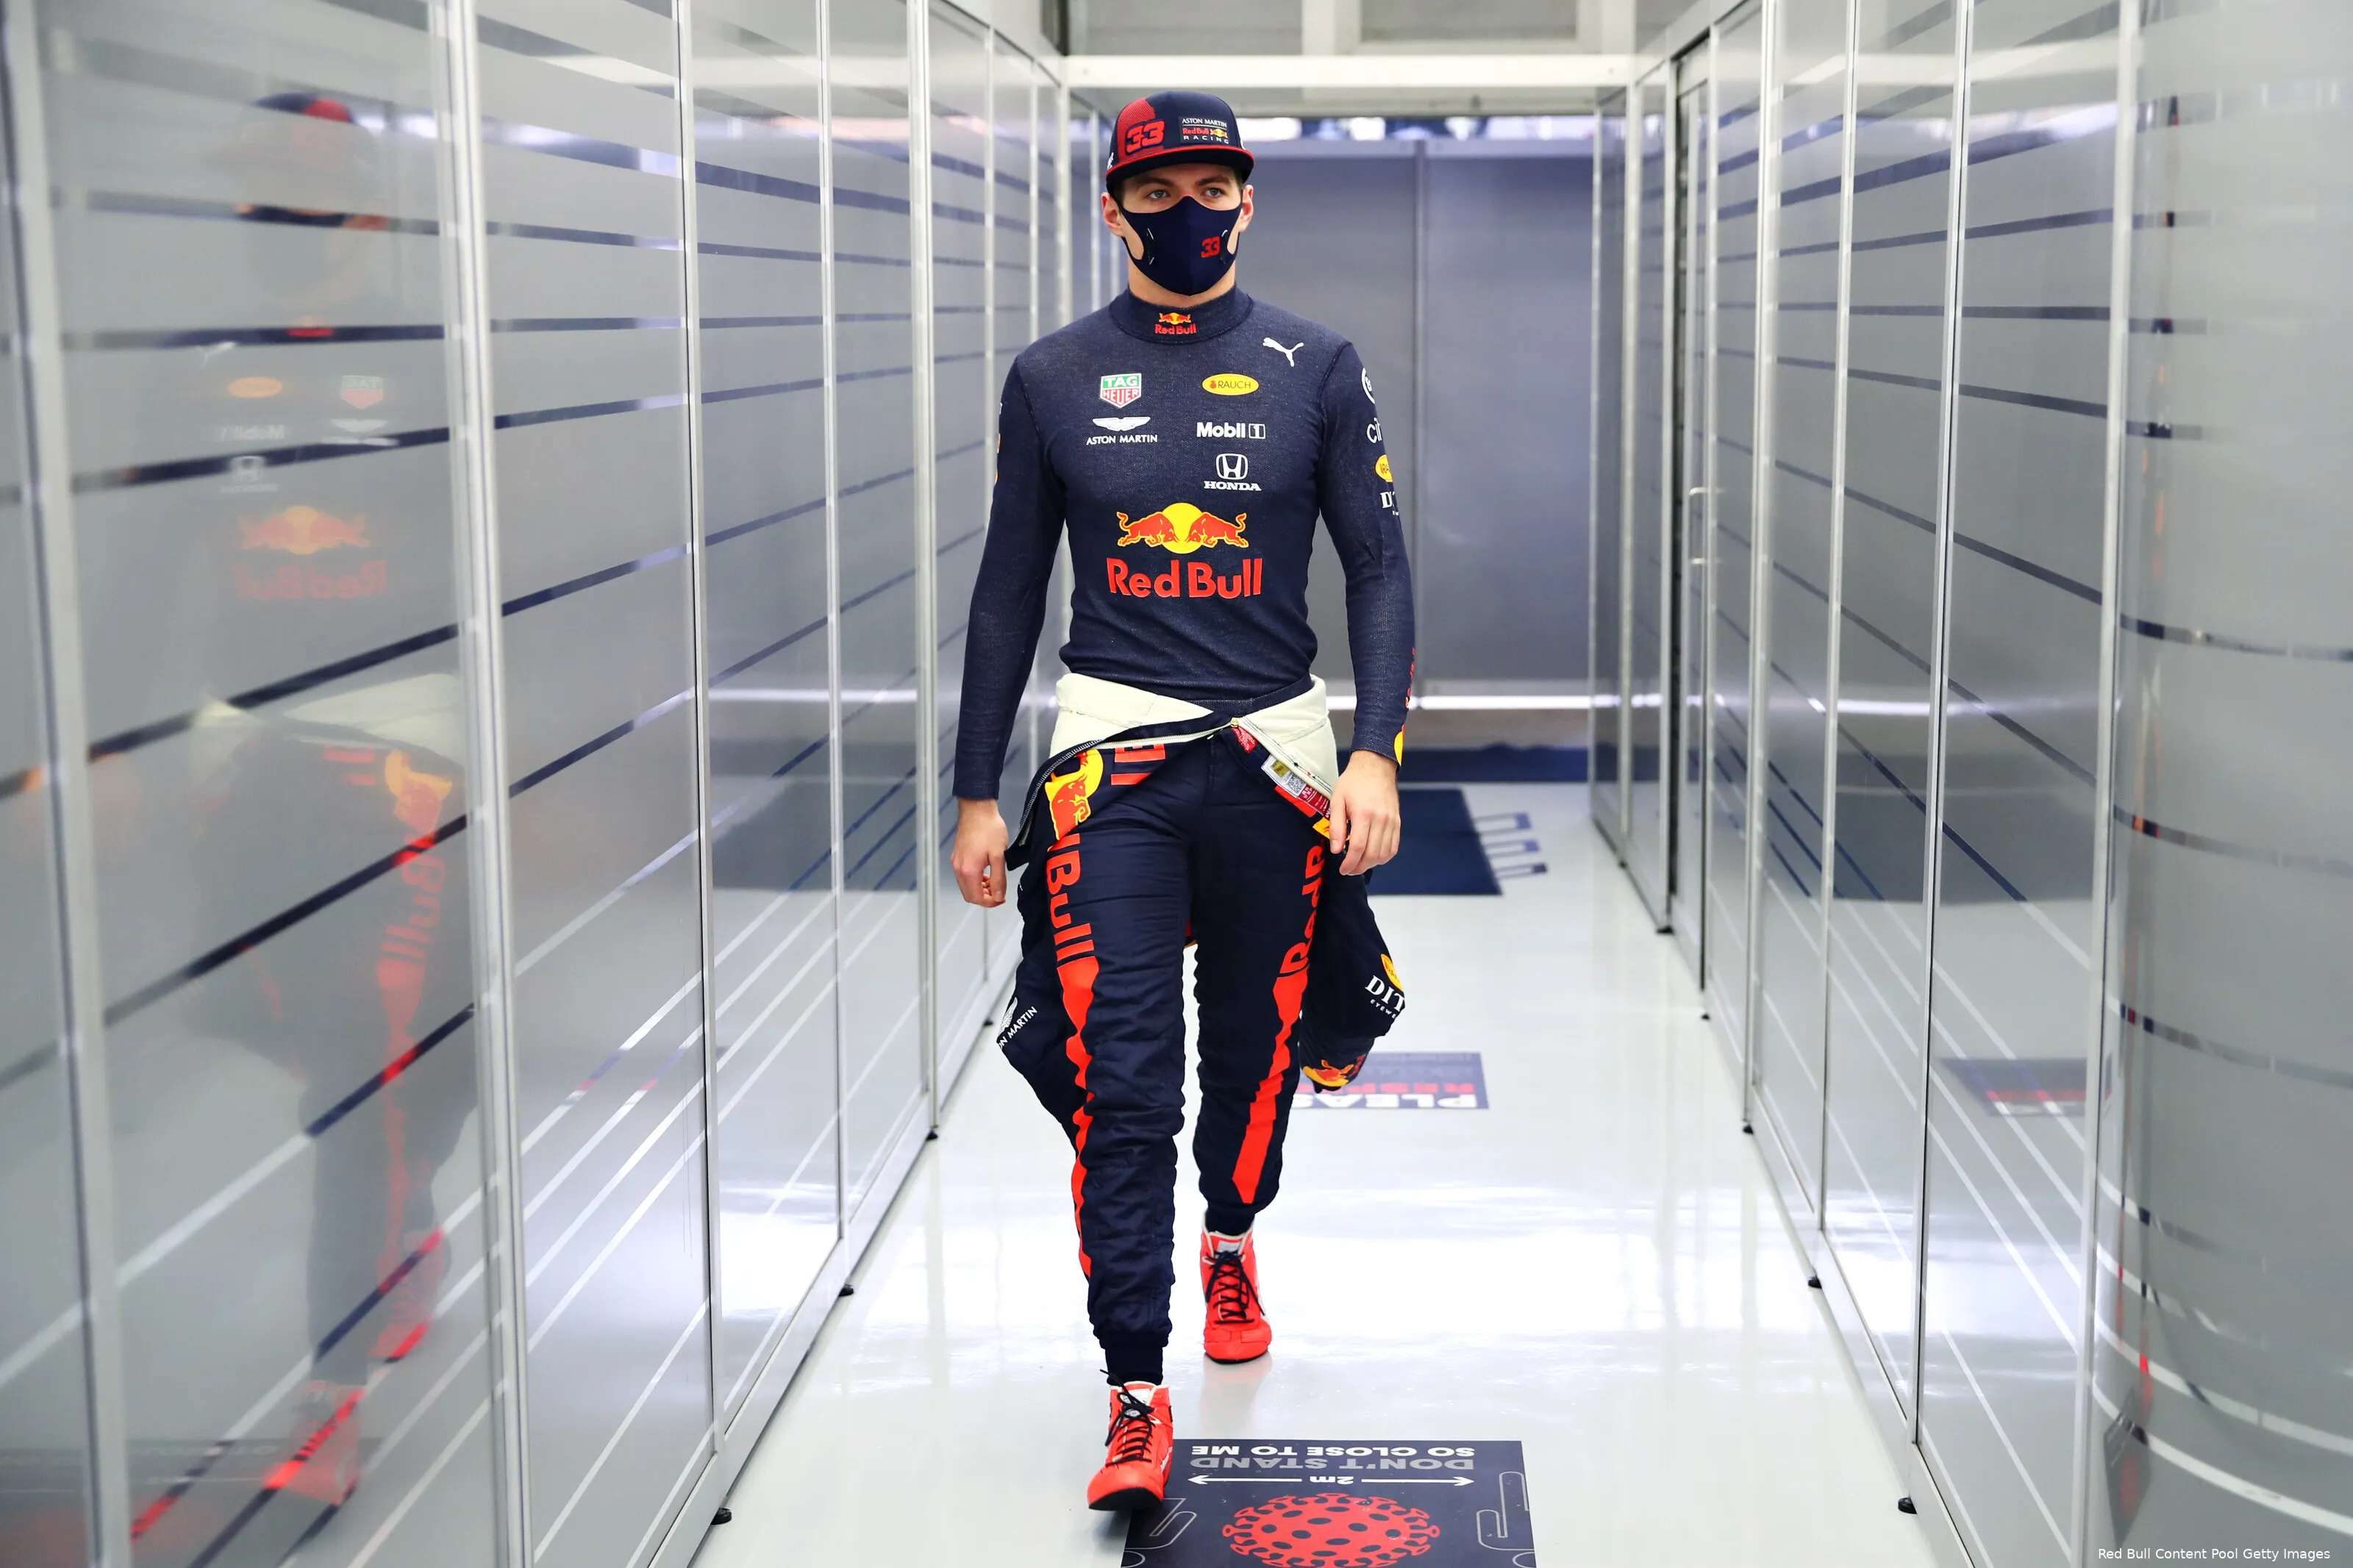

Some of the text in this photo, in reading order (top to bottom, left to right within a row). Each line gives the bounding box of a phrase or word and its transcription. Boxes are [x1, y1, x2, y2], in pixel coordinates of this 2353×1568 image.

[1204, 118, 1227, 128] MARTIN
[1126, 120, 1165, 154] 33
[1183, 135, 1229, 145] RACING
[1201, 236, 1221, 258] 33
[1154, 323, 1197, 334] Red Bull
[1104, 376, 1138, 388] TAG
[1218, 380, 1252, 389] RAUCH
[1103, 388, 1140, 406] HEUER
[1196, 421, 1246, 439] Mobil
[1086, 434, 1158, 445] ASTON MARTIN
[1204, 480, 1262, 491] HONDA
[1106, 557, 1263, 599] Red Bull
[1046, 850, 1095, 962] Bull
[1365, 975, 1405, 1012] DIT
[1007, 1006, 1038, 1039] MARTIN
[1192, 1445, 1475, 1457] SO CLOSE TO ME
[1190, 1457, 1475, 1470] DON'T STAND
[1309, 1475, 1354, 1485] 2m
